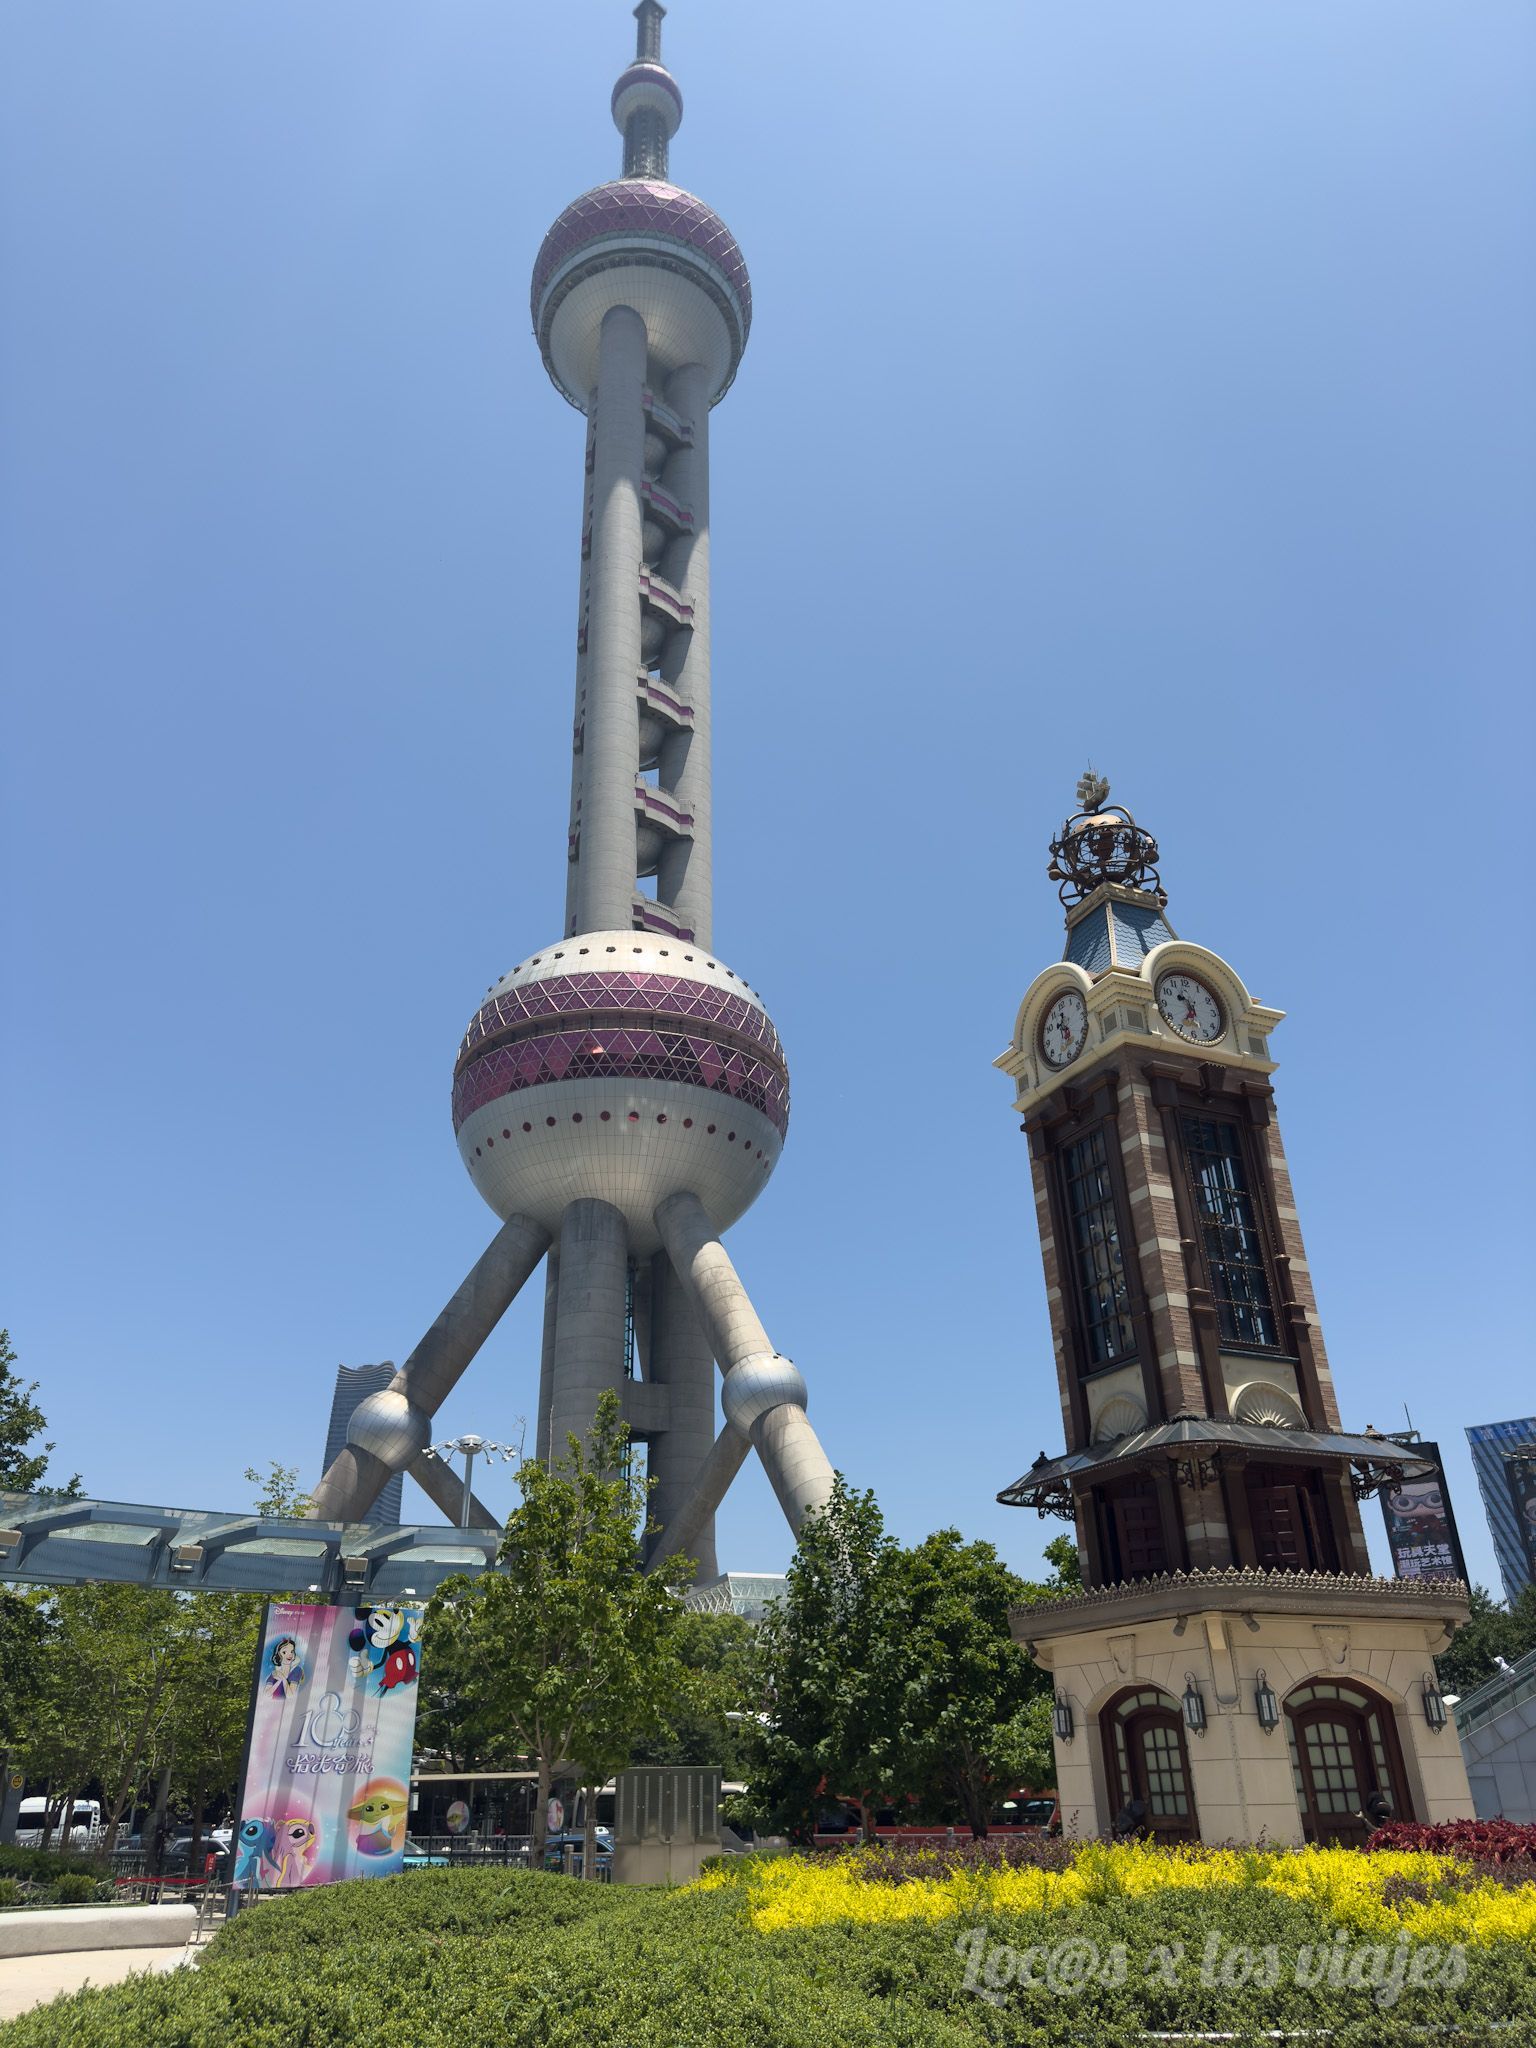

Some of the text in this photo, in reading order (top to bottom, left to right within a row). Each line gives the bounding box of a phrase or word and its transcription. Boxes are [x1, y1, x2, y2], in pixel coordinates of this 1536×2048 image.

[1170, 980, 1177, 989] 11
[1181, 979, 1190, 988] 12
[1163, 987, 1172, 996] 10
[1161, 999, 1167, 1007] 9
[1205, 997, 1211, 1005] 2
[1210, 1009, 1216, 1017] 3
[1210, 1022, 1216, 1030] 4
[1190, 1030, 1197, 1038] 6
[1202, 1029, 1209, 1037] 5
[1397, 1543, 1450, 1558] 玩具天堂
[273, 1606, 293, 1617] Disney
